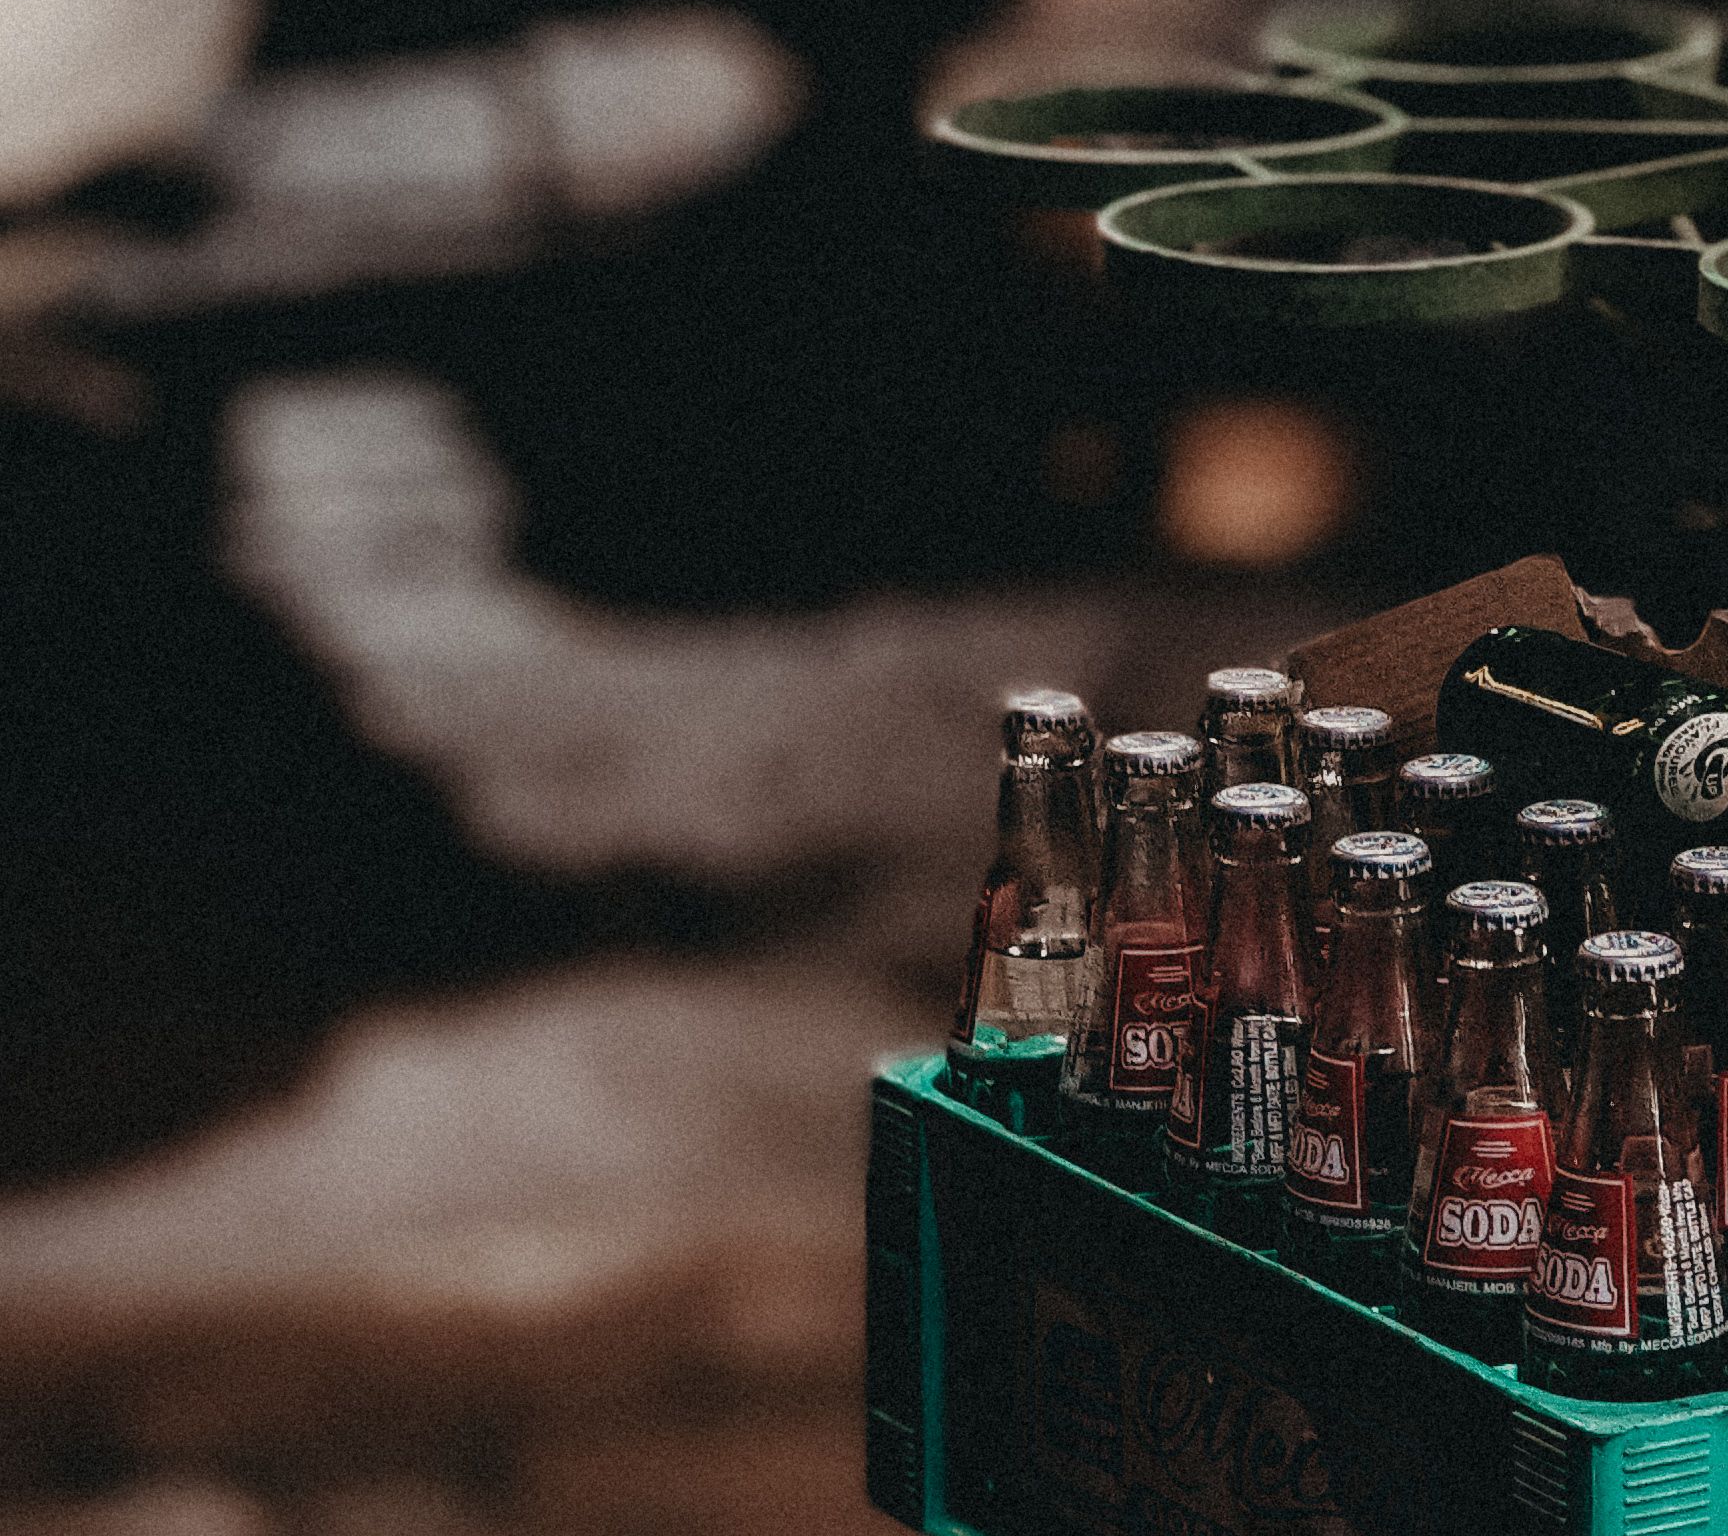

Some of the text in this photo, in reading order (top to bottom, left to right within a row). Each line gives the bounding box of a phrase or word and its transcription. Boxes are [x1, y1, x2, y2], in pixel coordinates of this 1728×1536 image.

[1452, 1165, 1536, 1189] Mecca
[1437, 1197, 1544, 1250] SODA
[1640, 1336, 1687, 1352] MECCA
